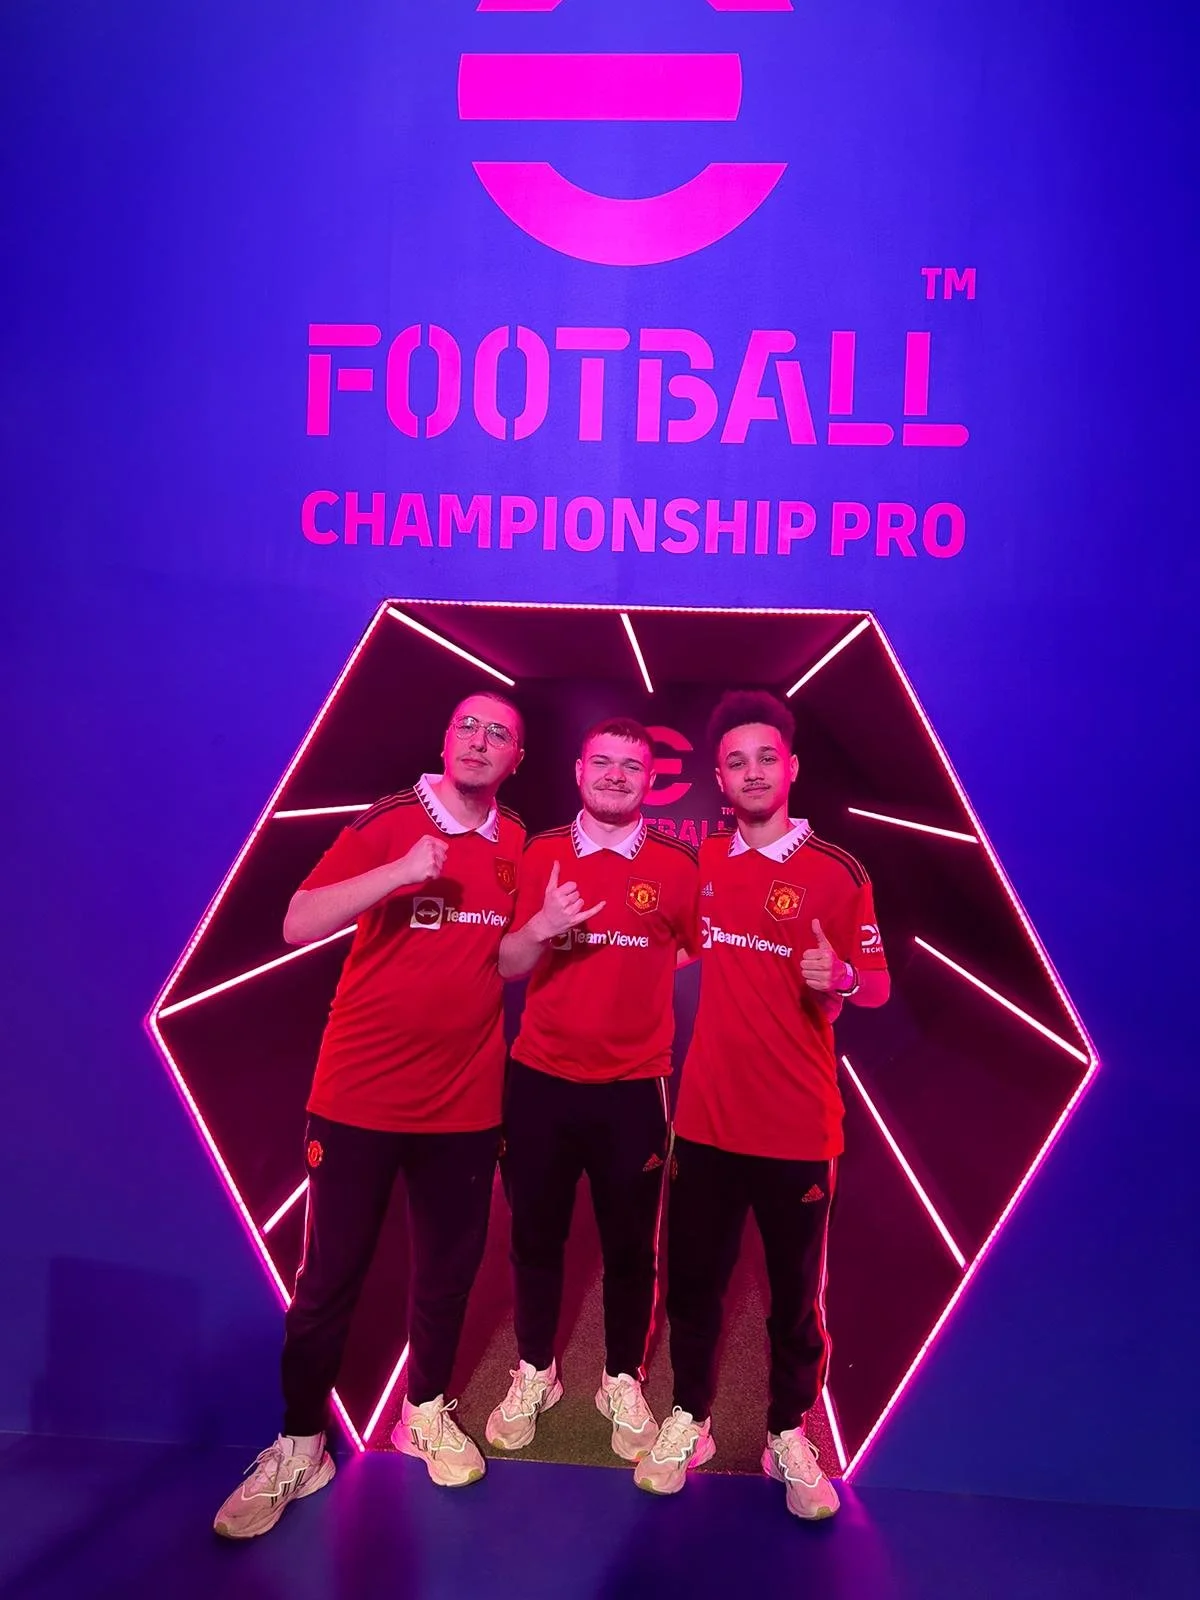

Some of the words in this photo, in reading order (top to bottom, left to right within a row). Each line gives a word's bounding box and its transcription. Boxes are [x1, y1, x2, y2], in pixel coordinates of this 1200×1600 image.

[921, 267, 977, 300] TM
[306, 323, 970, 448] FOOTBALL
[300, 489, 817, 556] CHAMPIONSHIP
[830, 501, 967, 559] PRO
[445, 906, 510, 927] TeamView
[711, 926, 793, 958] TeamViewer
